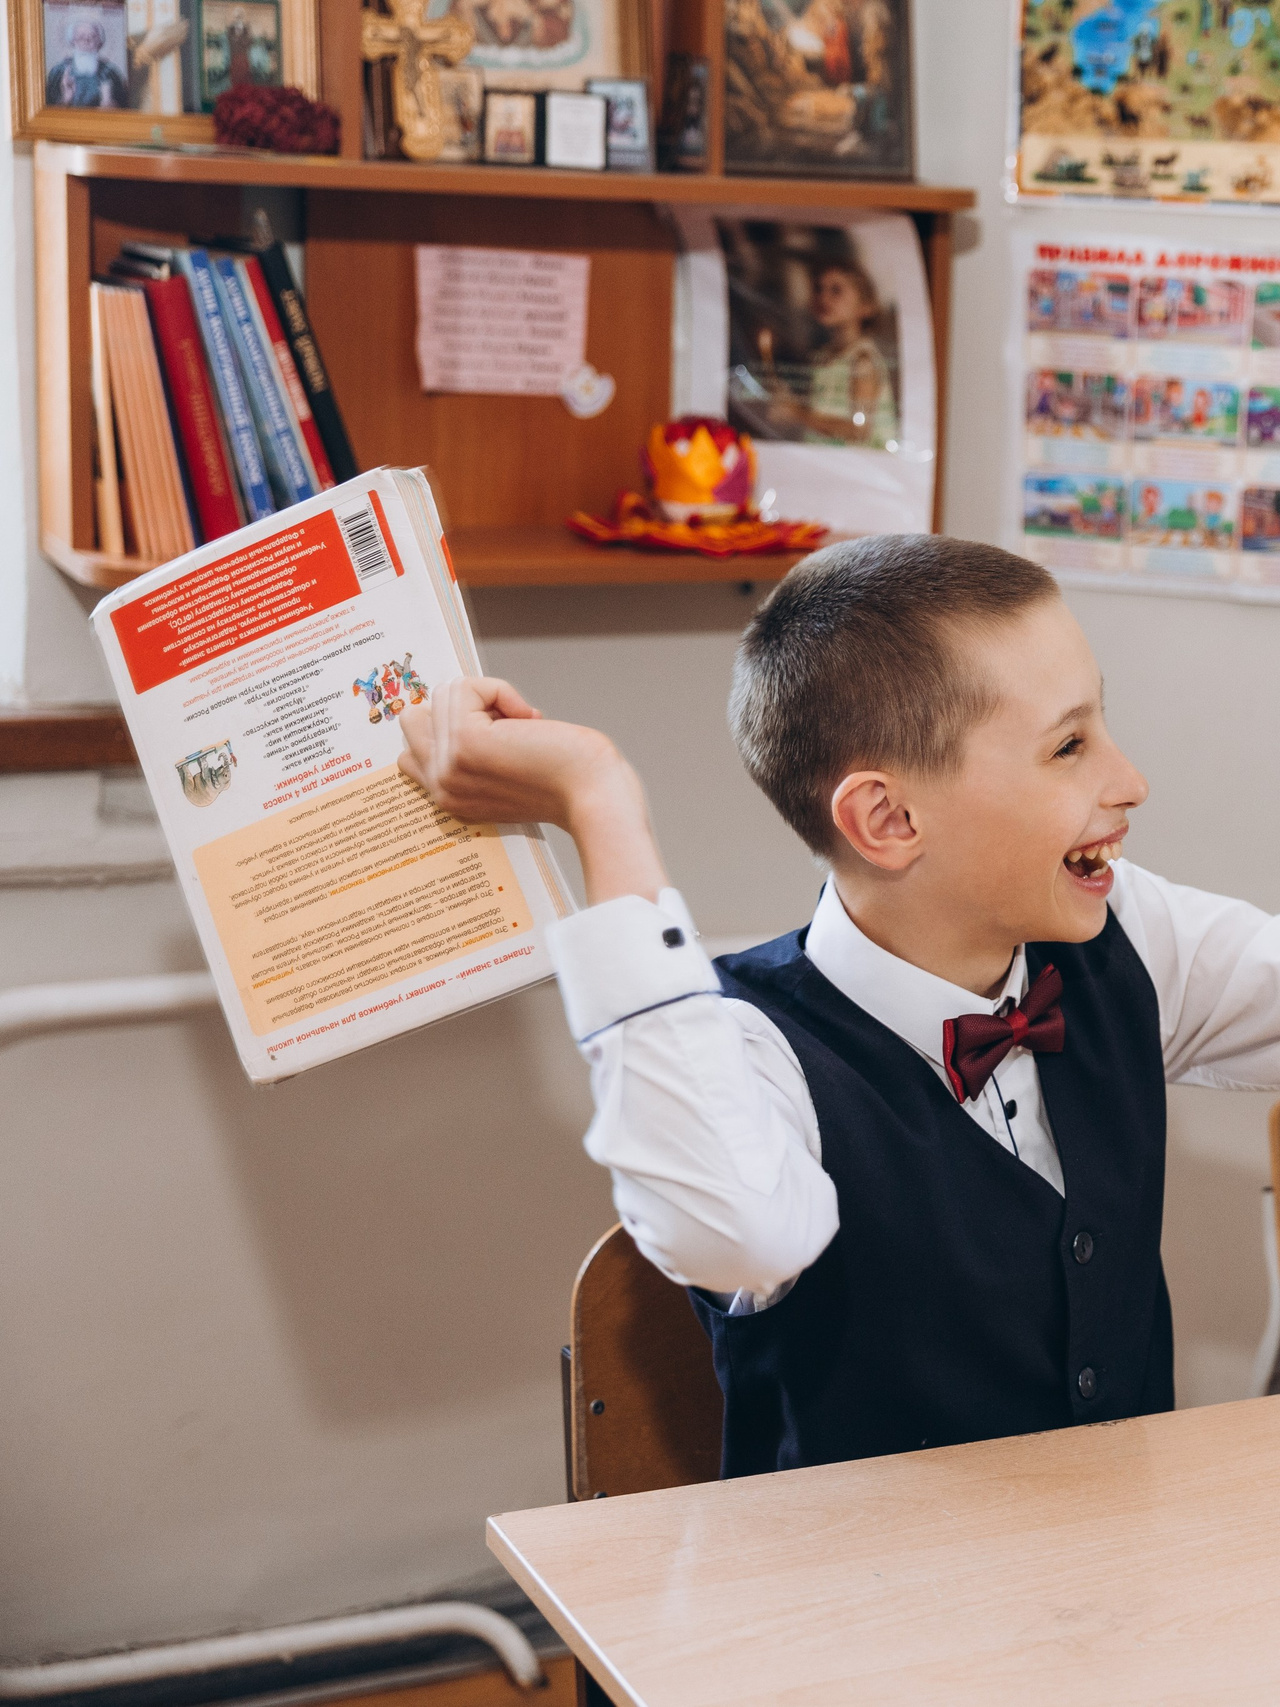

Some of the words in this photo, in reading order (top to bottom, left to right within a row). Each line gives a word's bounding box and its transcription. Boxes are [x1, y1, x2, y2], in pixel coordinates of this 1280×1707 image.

[246, 529, 300, 560] Федеральный
[272, 541, 296, 558] науки
[288, 539, 327, 563] Учебники
[212, 552, 249, 574] перечень
[229, 552, 275, 579] Российской
[230, 554, 290, 588] рекомендованы
[177, 568, 215, 591] школьных
[189, 571, 231, 597] Федерации
[228, 562, 298, 601] образовательному
[238, 575, 295, 607] Федеральному
[149, 593, 186, 615] включены
[176, 581, 233, 614] Министерством
[193, 593, 230, 616] стандарту
[255, 579, 312, 611] общественную
[270, 594, 302, 614] прошли
[135, 606, 179, 634] образования
[175, 599, 240, 636] государственному
[214, 603, 257, 628] экспертизу
[276, 601, 315, 624] Учебники
[181, 622, 238, 655] педагогическую
[205, 622, 216, 633] на
[237, 616, 278, 640] комплекта
[161, 626, 207, 654] соответствие
[236, 677, 272, 700] культуры
[208, 692, 238, 711] народов
[318, 760, 363, 786] комплект
[319, 750, 352, 772] входят
[362, 756, 373, 769] В
[293, 788, 301, 799] 4
[299, 778, 319, 794] для
[261, 790, 294, 811] класса
[403, 977, 447, 1001] комплект
[339, 1010, 358, 1026] для
[356, 992, 405, 1020] учебников
[294, 1019, 341, 1045] начальной
[265, 1036, 295, 1055] школы
